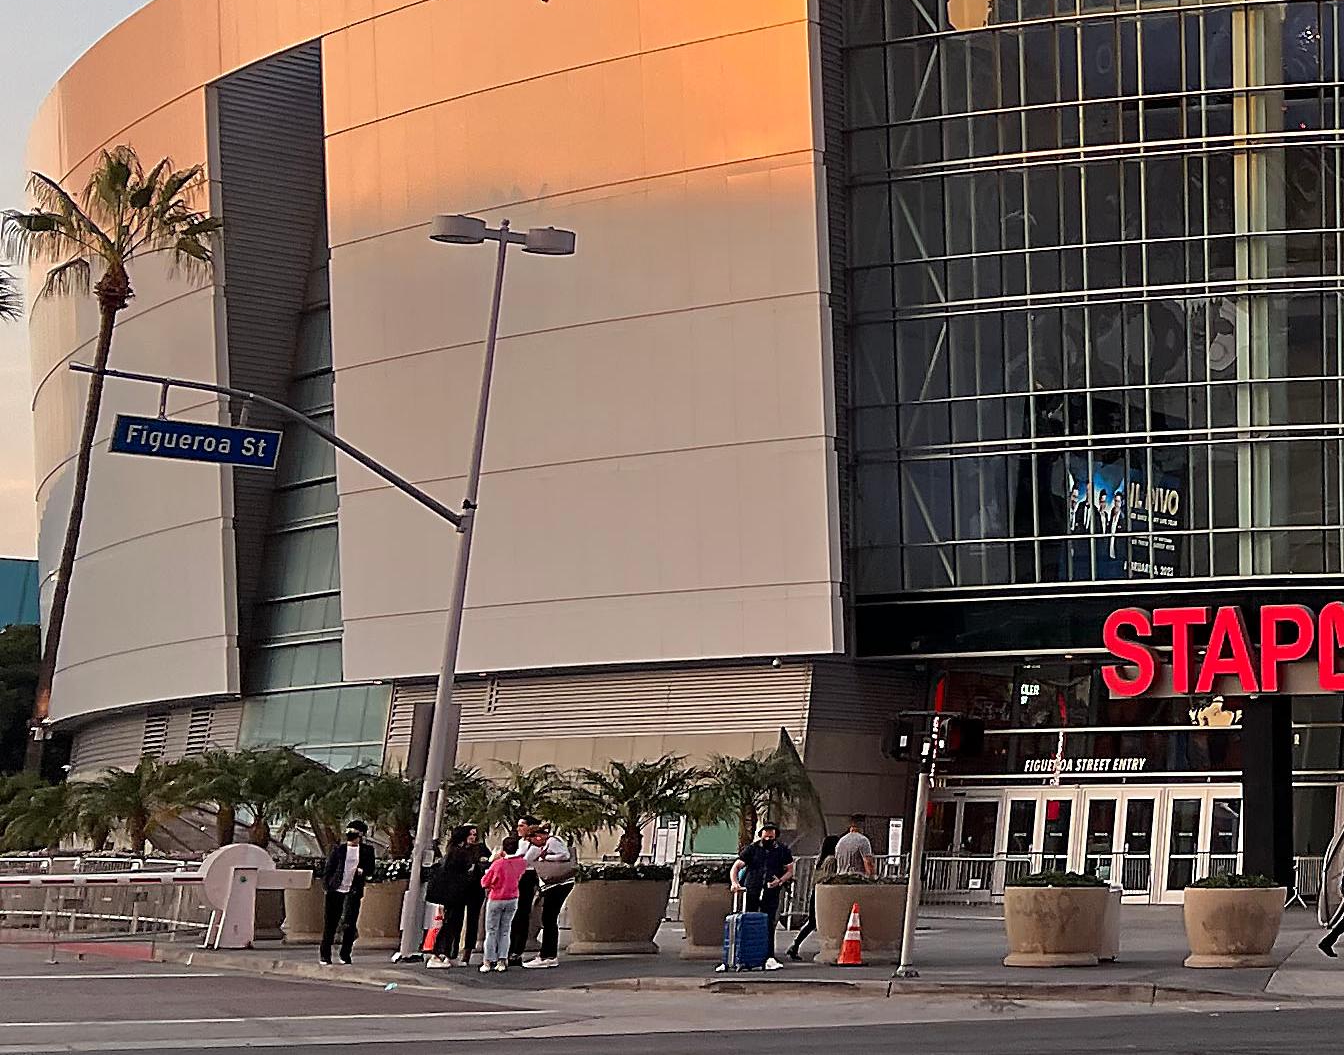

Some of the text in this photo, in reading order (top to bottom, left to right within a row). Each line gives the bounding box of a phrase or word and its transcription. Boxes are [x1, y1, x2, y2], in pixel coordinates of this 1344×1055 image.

[125, 424, 269, 458] Figueroa St
[1075, 758, 1112, 771] STREET
[1112, 757, 1147, 771] ENTRY
